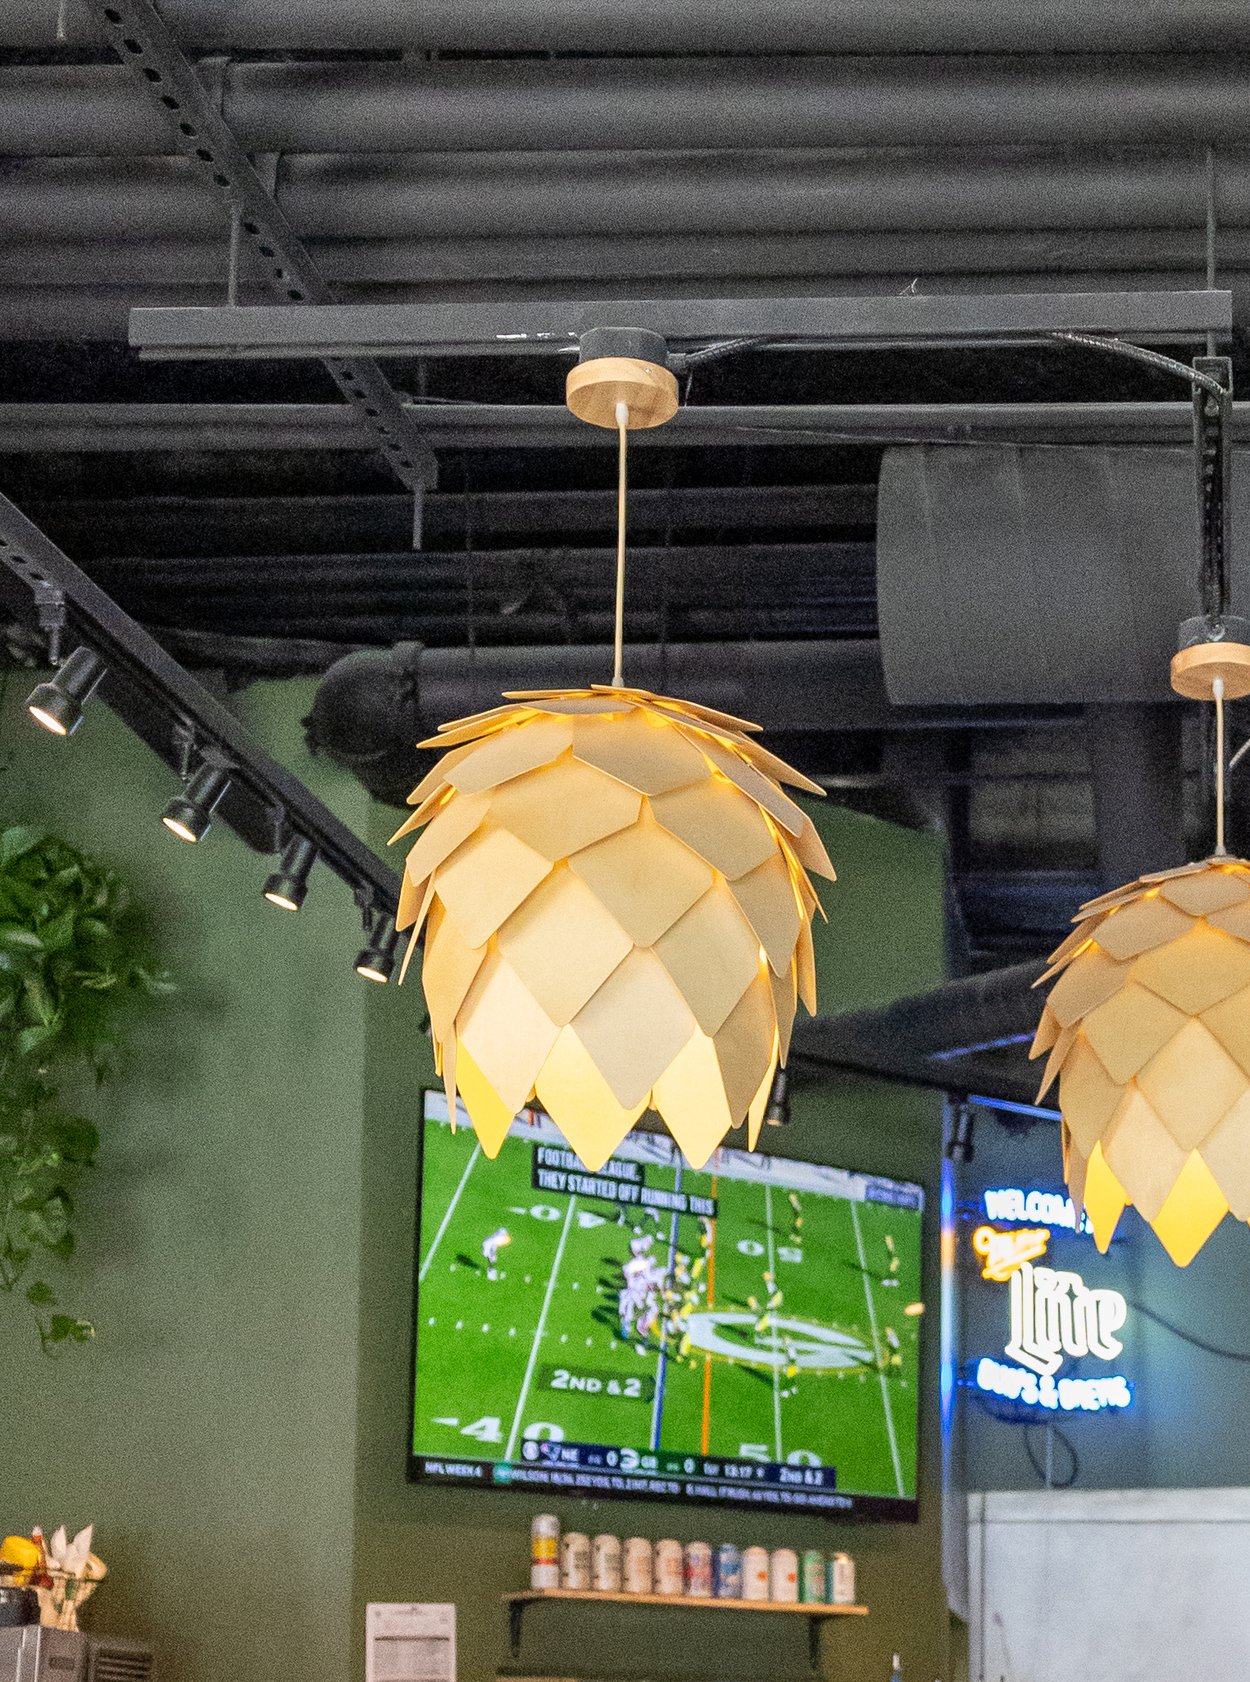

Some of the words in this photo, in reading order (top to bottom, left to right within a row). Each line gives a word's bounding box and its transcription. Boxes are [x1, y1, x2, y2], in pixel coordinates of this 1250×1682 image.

[537, 1168, 567, 1189] THEY
[567, 1173, 618, 1199] STARTED
[984, 1188, 1088, 1234] WELCOM
[1004, 1261, 1127, 1376] Lite
[550, 1369, 602, 1393] 2ND
[623, 1378, 641, 1397] 2
